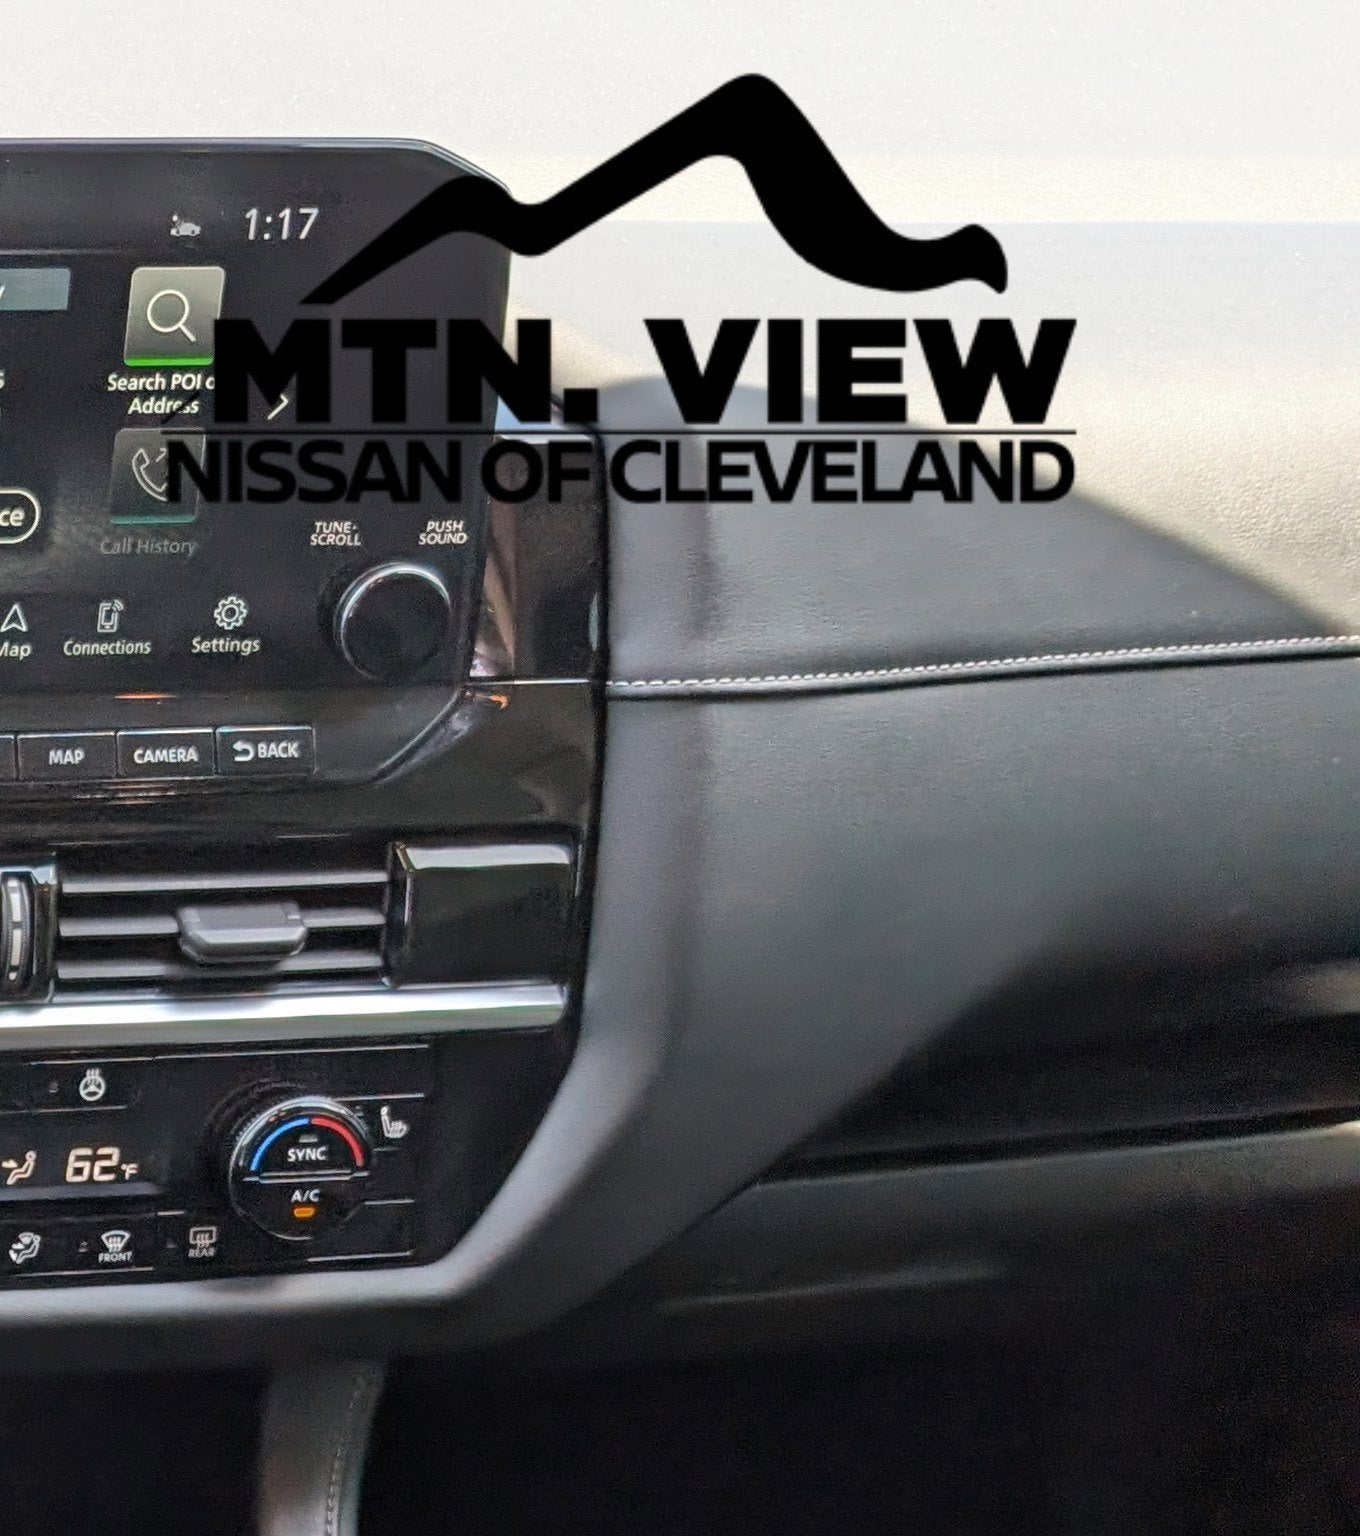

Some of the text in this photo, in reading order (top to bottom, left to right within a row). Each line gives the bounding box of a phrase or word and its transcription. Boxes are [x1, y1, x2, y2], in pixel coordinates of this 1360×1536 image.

[244, 206, 319, 241] 1:17
[107, 373, 166, 392] Search
[171, 373, 202, 391] POI
[426, 521, 463, 532] PUSH
[310, 534, 361, 547] SCROLL
[419, 532, 467, 545] SOUND
[100, 539, 132, 555] Call
[63, 639, 152, 657] Connections
[191, 636, 260, 656] Settings
[48, 748, 85, 765] MAP
[134, 746, 198, 764] CAMERA
[258, 741, 299, 759] BACK
[287, 1148, 327, 1162] SYNC
[291, 1188, 321, 1202] A/C
[98, 1251, 133, 1263] FRONT
[188, 1248, 215, 1258] REAR
